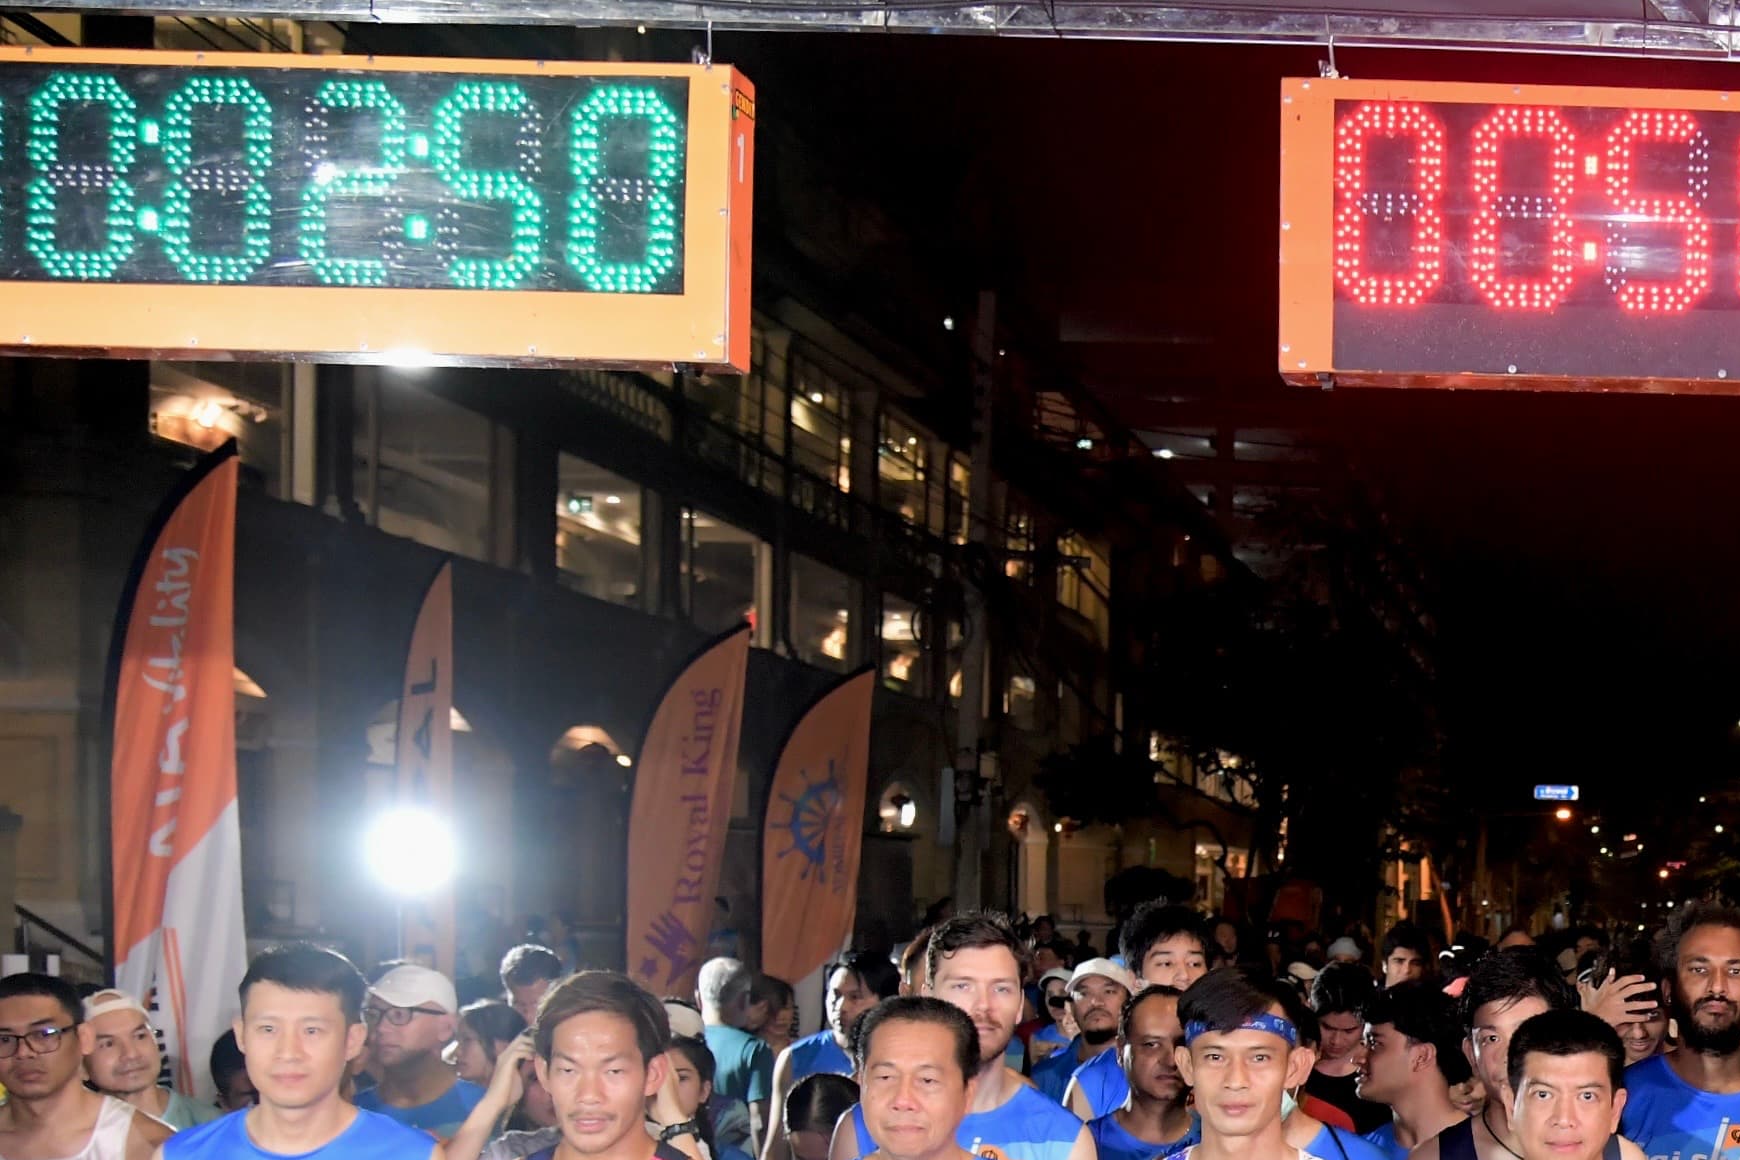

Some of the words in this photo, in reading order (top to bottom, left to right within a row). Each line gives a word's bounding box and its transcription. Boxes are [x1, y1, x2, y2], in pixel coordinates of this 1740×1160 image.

[0, 72, 678, 293] 0:02:50
[681, 687, 722, 778] King
[674, 793, 711, 905] Royal
